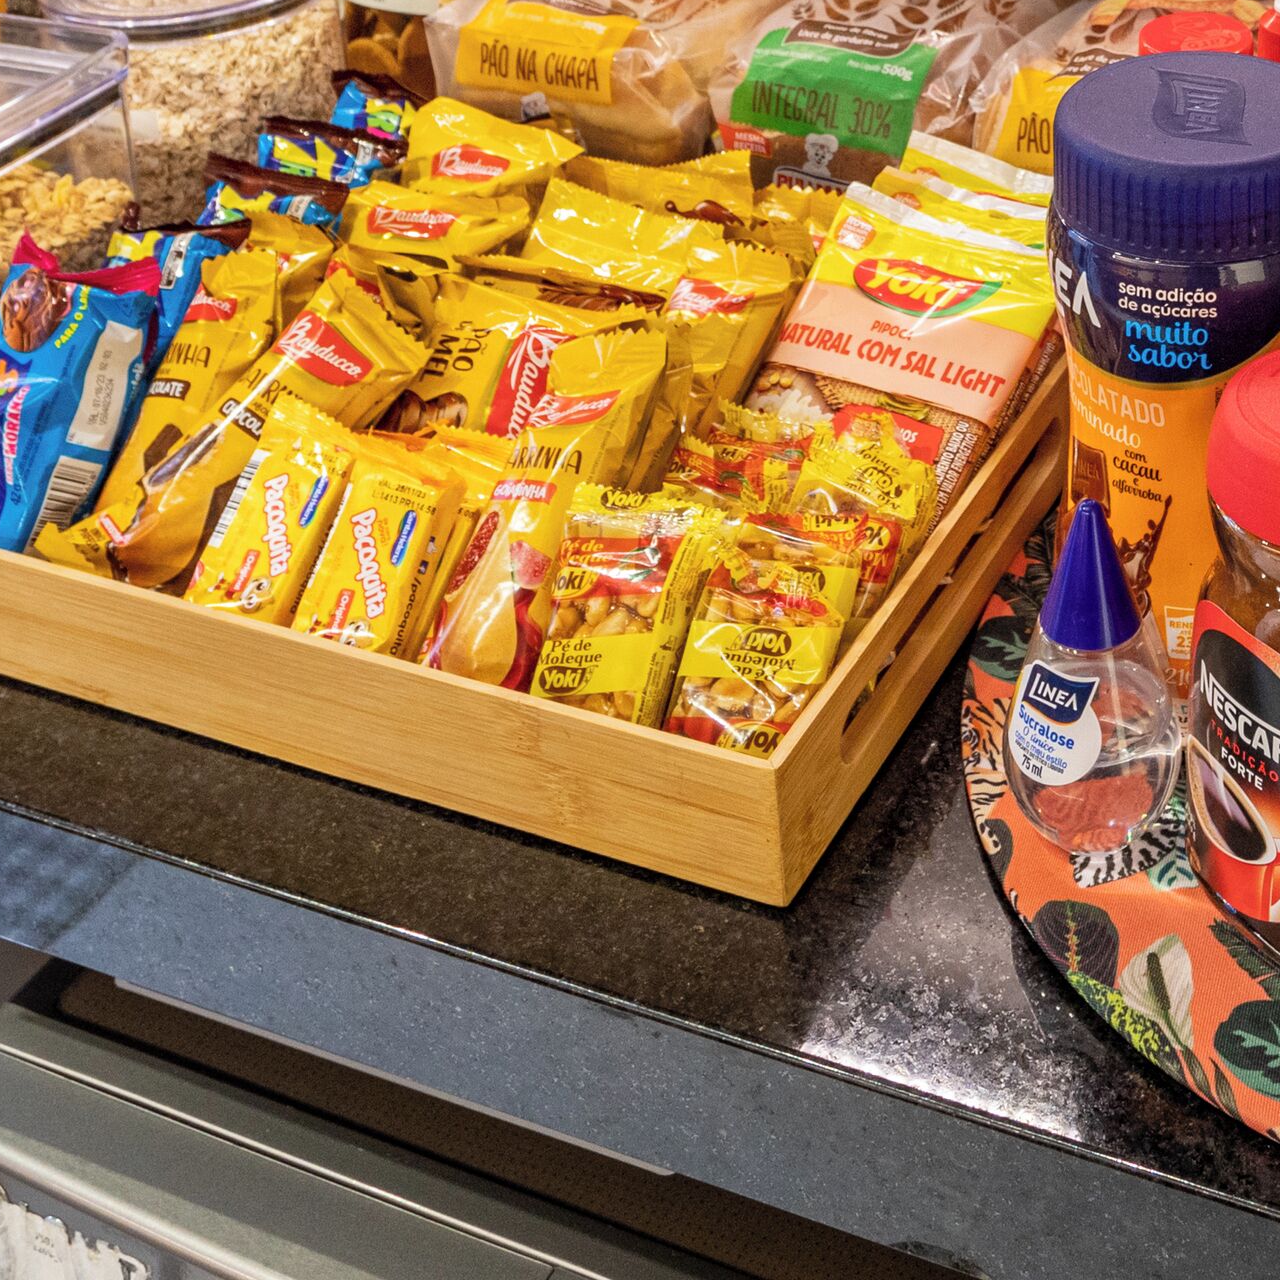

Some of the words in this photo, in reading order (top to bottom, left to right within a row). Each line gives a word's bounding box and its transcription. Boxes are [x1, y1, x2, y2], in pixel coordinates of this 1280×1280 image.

[479, 39, 509, 79] PÃO
[515, 47, 537, 83] NA
[543, 51, 600, 93] CHAPA
[881, 63, 913, 82] 500g
[751, 79, 840, 130] INTEGRAL
[847, 95, 893, 139] 30%
[1016, 111, 1052, 155] PÃO
[1118, 280, 1153, 300] sem
[1158, 287, 1218, 308] adição
[1118, 295, 1138, 311] de
[1140, 300, 1218, 320] açúcares
[54, 321, 79, 349] PARA
[74, 312, 84, 322] O
[1125, 319, 1209, 346] muito
[277, 314, 363, 379] Bauducco
[420, 334, 461, 383] MEL
[779, 322, 851, 356] NATURAL
[857, 338, 902, 368] COM
[899, 350, 936, 379] SAL
[940, 361, 1006, 398] LIGHT
[1127, 342, 1213, 371] sabor
[4, 384, 31, 460] MORANGO
[948, 433, 965, 453] BAIXO
[957, 420, 969, 433] OU
[506, 444, 583, 476] ARRINHA
[1112, 455, 1163, 483] cacau
[1124, 448, 1148, 464] com
[944, 469, 961, 495] VALOR
[1112, 477, 1164, 504] alfarroba
[1133, 477, 1139, 487] e
[604, 488, 645, 508] Yoki
[939, 489, 950, 505] EM
[262, 472, 293, 577] Paçoquita
[233, 552, 255, 593] Original
[351, 507, 390, 620] Paçoquita
[551, 640, 571, 654] Pé
[572, 640, 592, 652] de
[745, 631, 788, 653] Yoki
[539, 652, 603, 668] Moleque
[720, 651, 797, 671] Moleque
[543, 668, 583, 691] Yoki
[1028, 672, 1078, 712] LINEA
[1018, 703, 1075, 750] Sucralose
[1022, 725, 1030, 737] O
[1030, 733, 1055, 754] único
[1014, 729, 1026, 742] com
[1030, 743, 1045, 759] meu
[1045, 752, 1068, 770] estilo
[1210, 718, 1280, 784] TRADIÇÃO
[1020, 753, 1032, 770] 75
[1031, 761, 1044, 779] ml
[1220, 746, 1264, 792] FORTE
